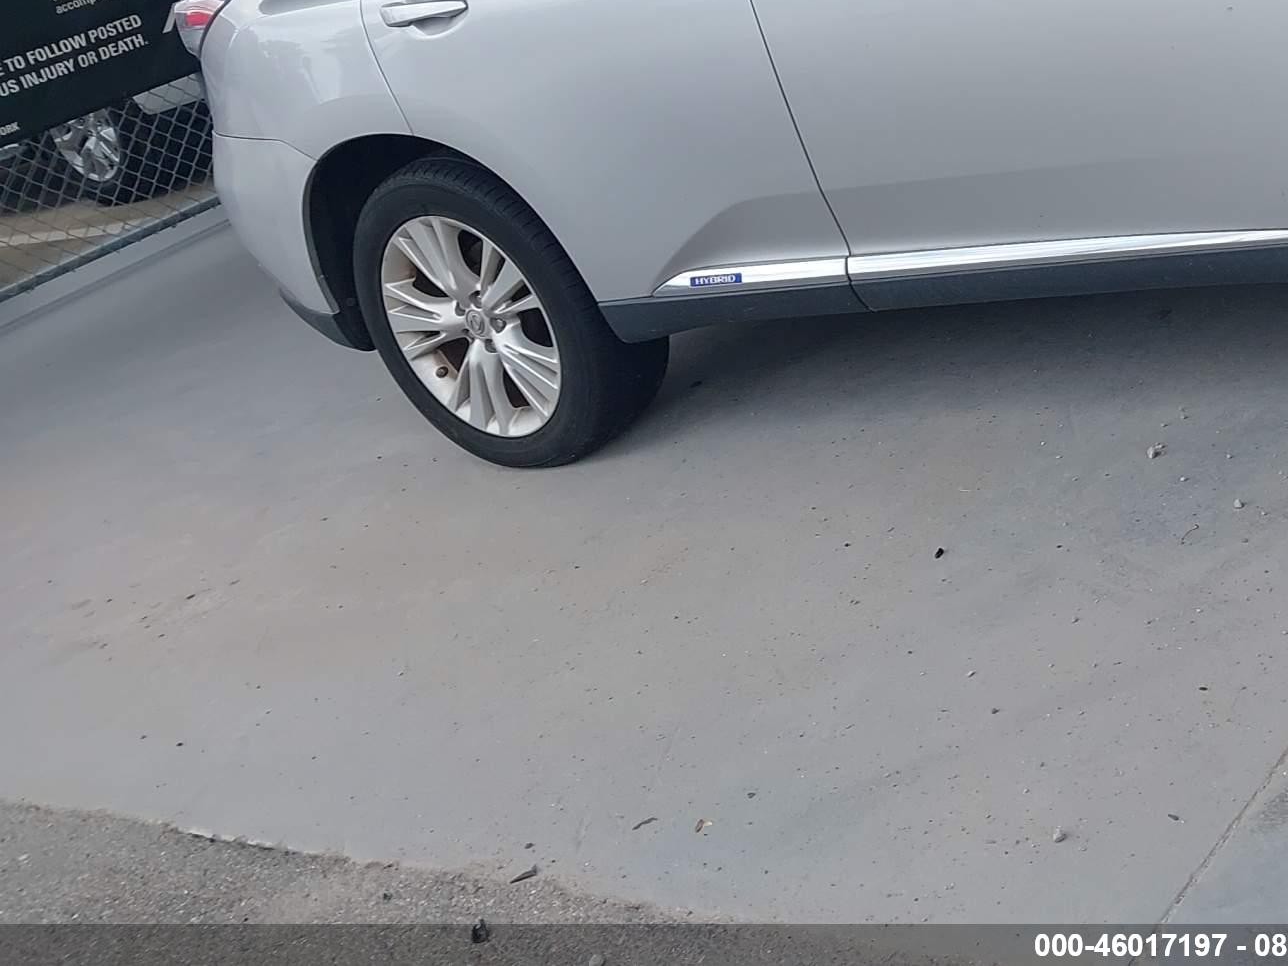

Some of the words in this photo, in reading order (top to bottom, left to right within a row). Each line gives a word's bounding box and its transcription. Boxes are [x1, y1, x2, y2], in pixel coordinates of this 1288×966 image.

[3, 55, 26, 73] TO
[26, 33, 87, 65] FOLLOW
[87, 14, 142, 43] POSTED
[19, 58, 75, 89] INJURY
[77, 50, 99, 68] OR
[98, 33, 149, 61] DEATH.
[695, 274, 736, 285] HYBRID
